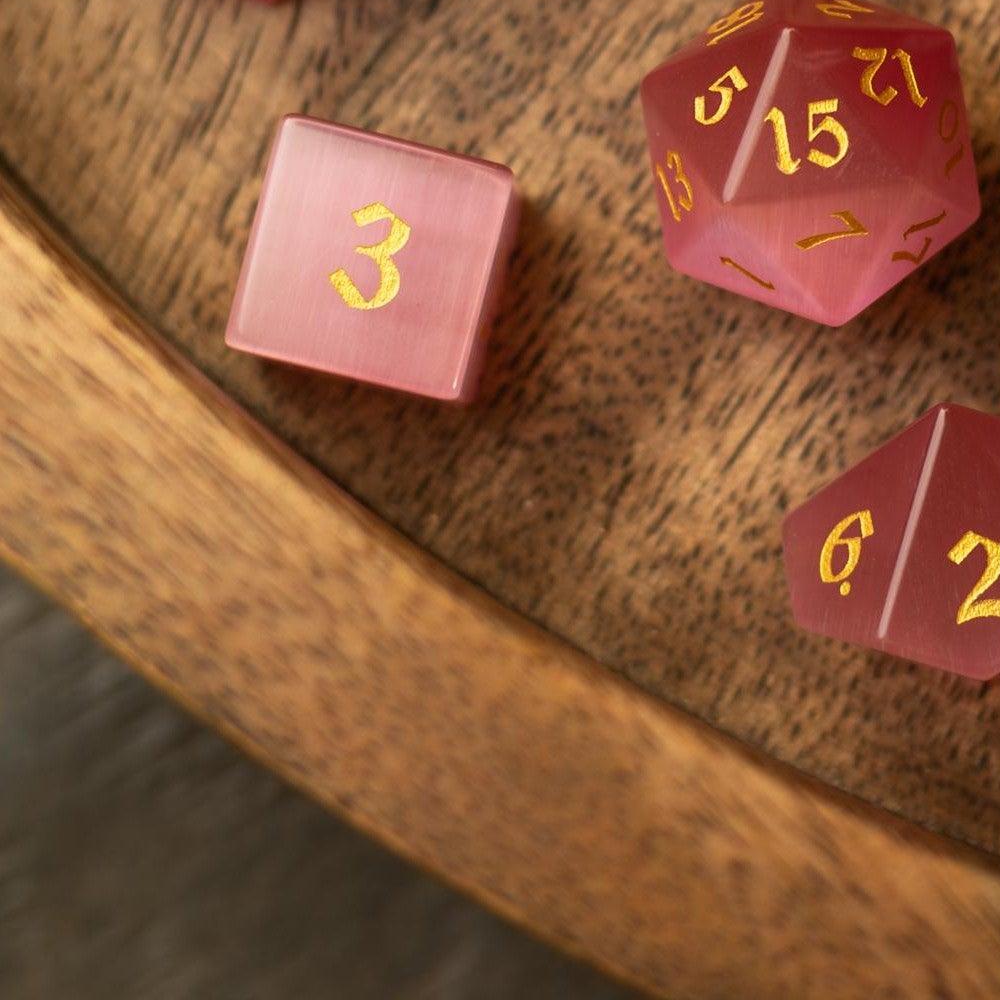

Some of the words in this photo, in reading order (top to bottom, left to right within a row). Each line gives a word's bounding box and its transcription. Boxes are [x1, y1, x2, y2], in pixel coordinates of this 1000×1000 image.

[693, 65, 749, 126] 5
[851, 46, 929, 109] 12
[764, 98, 850, 176] 15
[656, 151, 694, 223] 13
[328, 200, 412, 312] 3
[795, 209, 869, 251] 7
[718, 256, 777, 290] 1
